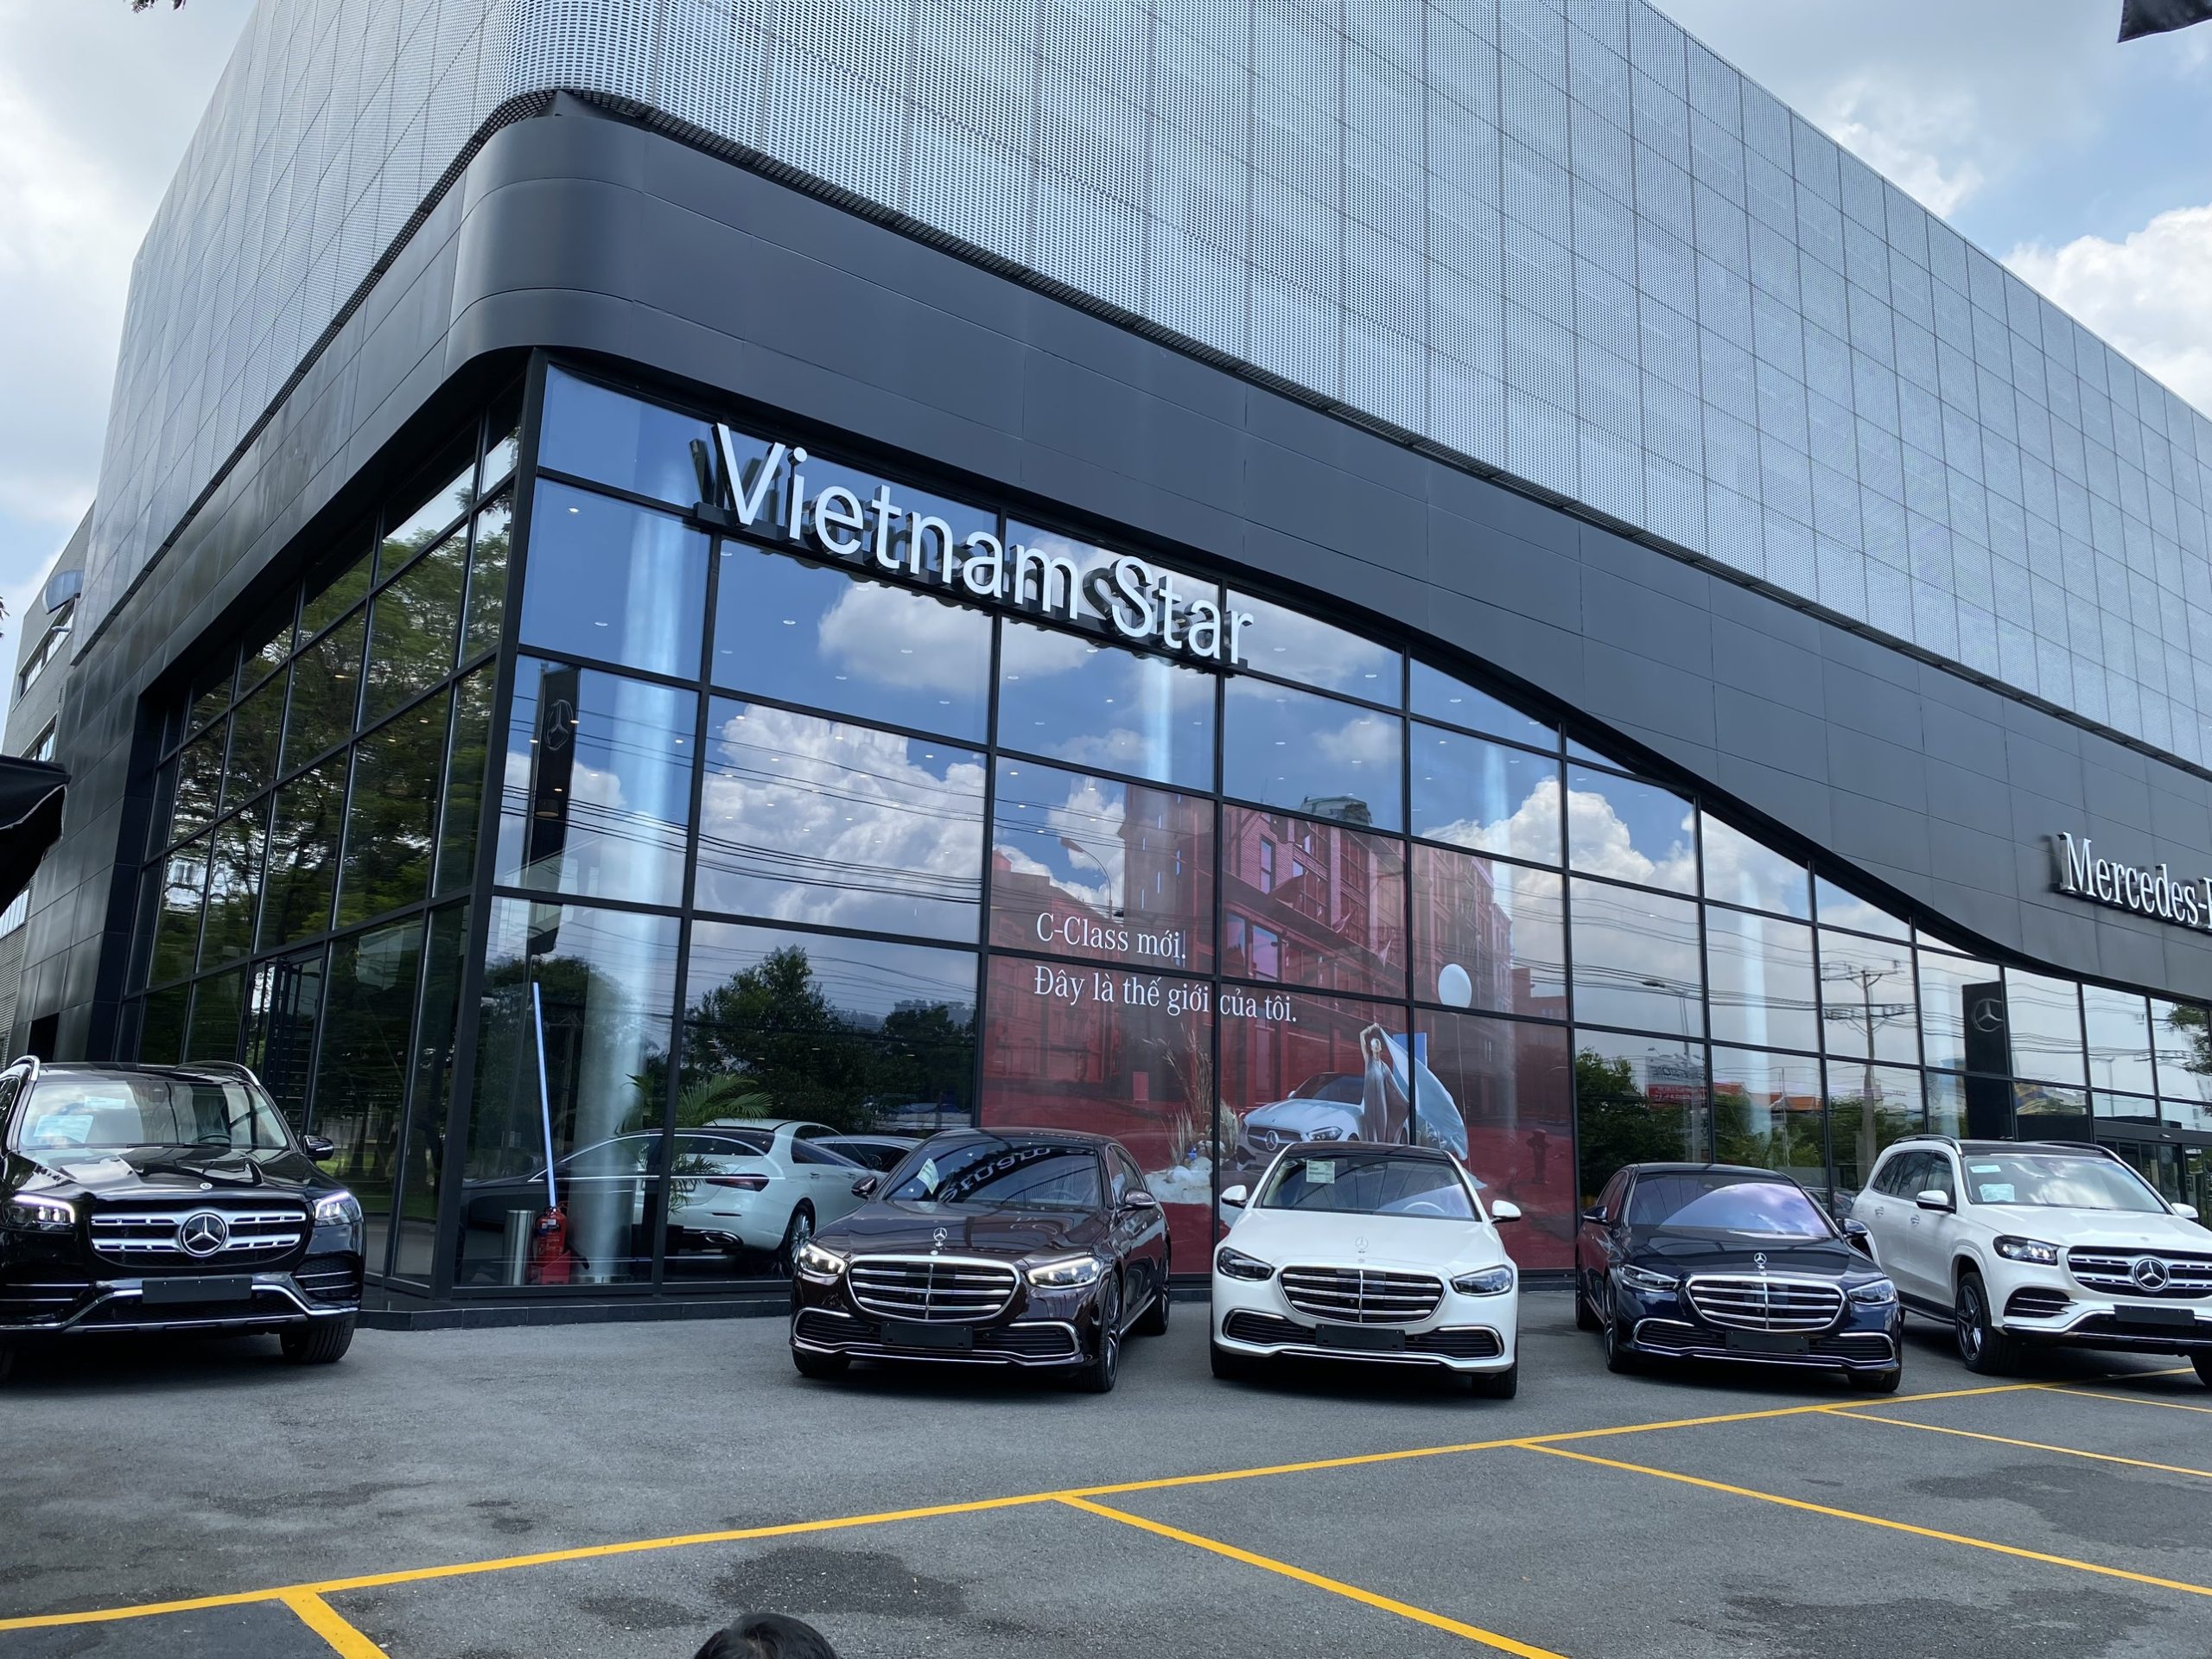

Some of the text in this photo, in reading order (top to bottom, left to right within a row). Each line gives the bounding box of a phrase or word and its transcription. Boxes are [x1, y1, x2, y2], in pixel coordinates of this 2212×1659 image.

[716, 422, 1254, 664] Vietnam Star
[1036, 912, 1129, 952] C-Class
[1033, 964, 1297, 1022] Đây là thế giới của tôi.
